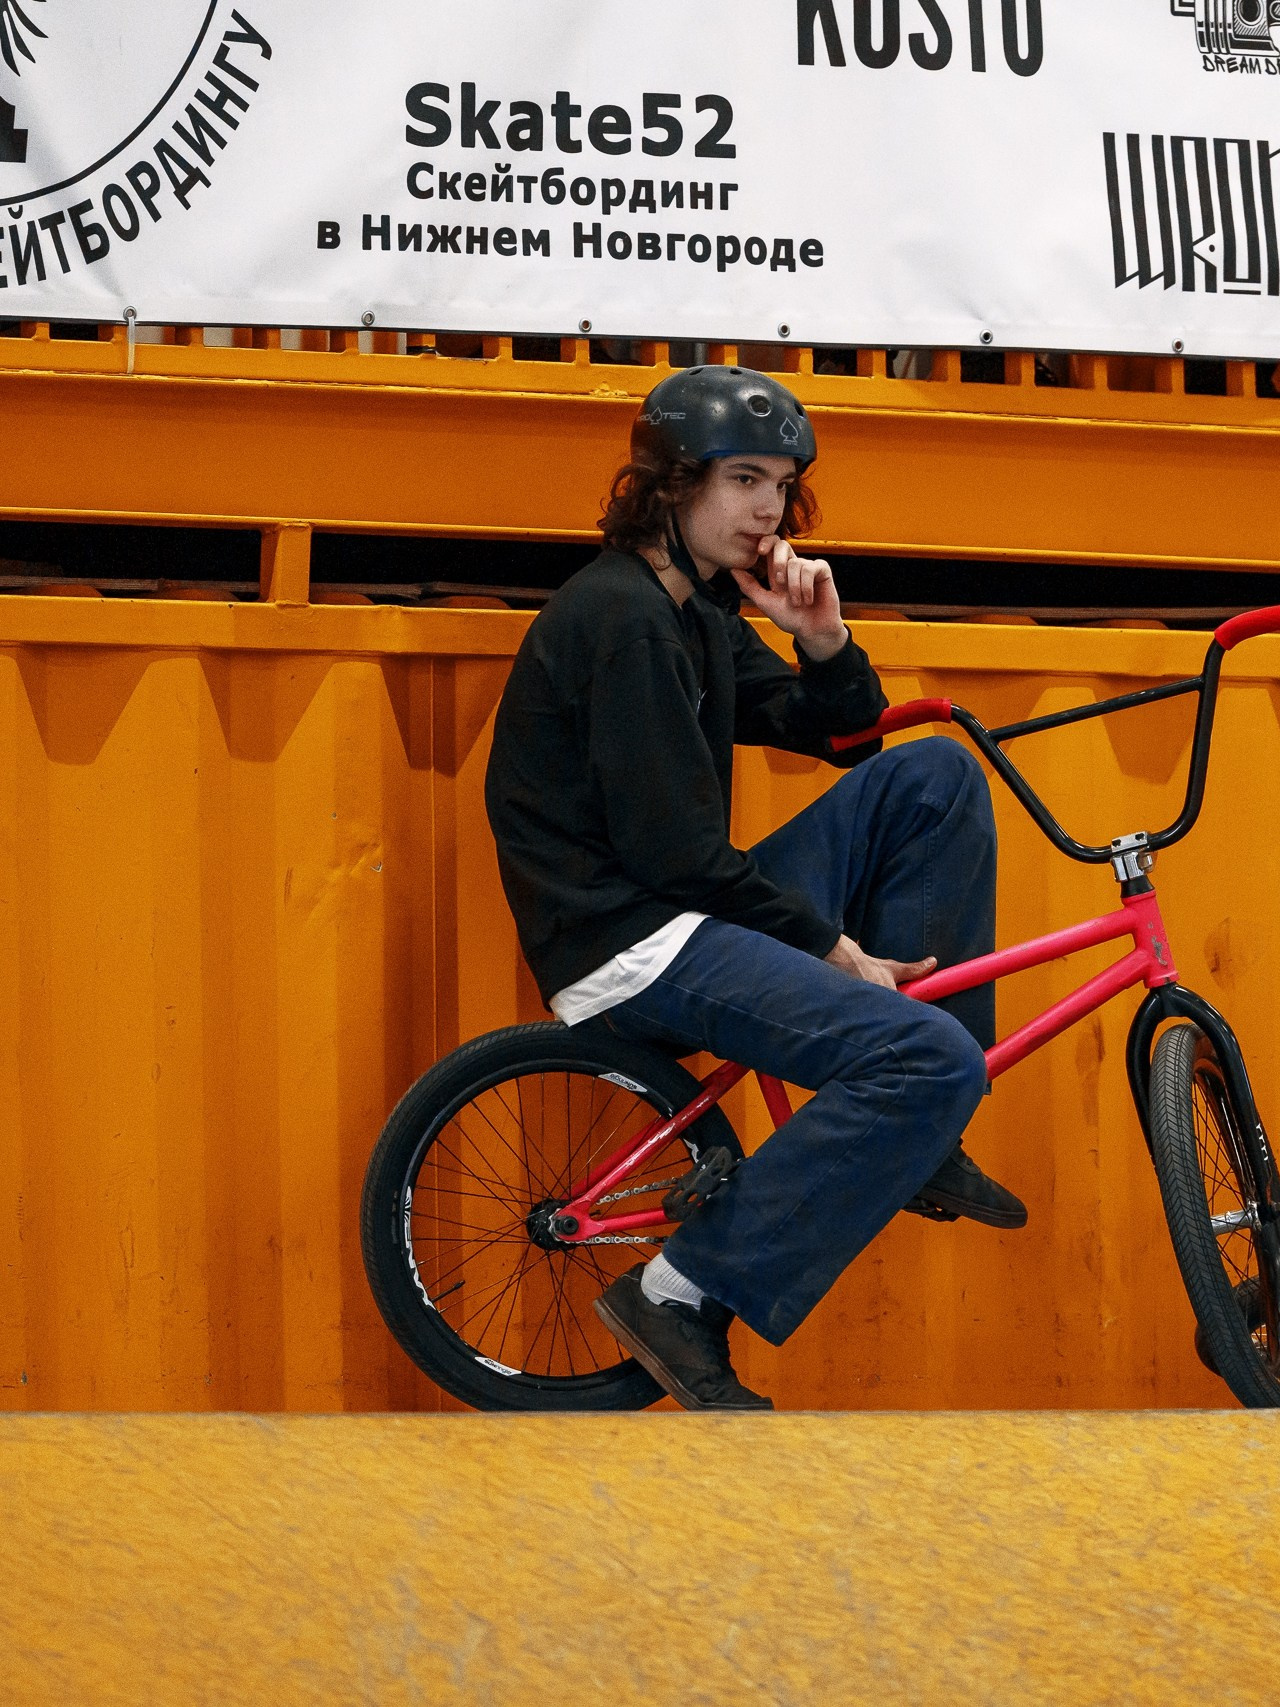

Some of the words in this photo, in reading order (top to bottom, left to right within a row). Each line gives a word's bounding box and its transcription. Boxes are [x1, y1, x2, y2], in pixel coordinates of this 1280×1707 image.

[1202, 54, 1261, 76] DREAM
[406, 82, 737, 160] Skate52
[406, 162, 738, 216] Скейтбординг
[317, 221, 341, 250] в
[363, 214, 551, 258] Нижнем
[574, 222, 824, 273] Новгороде
